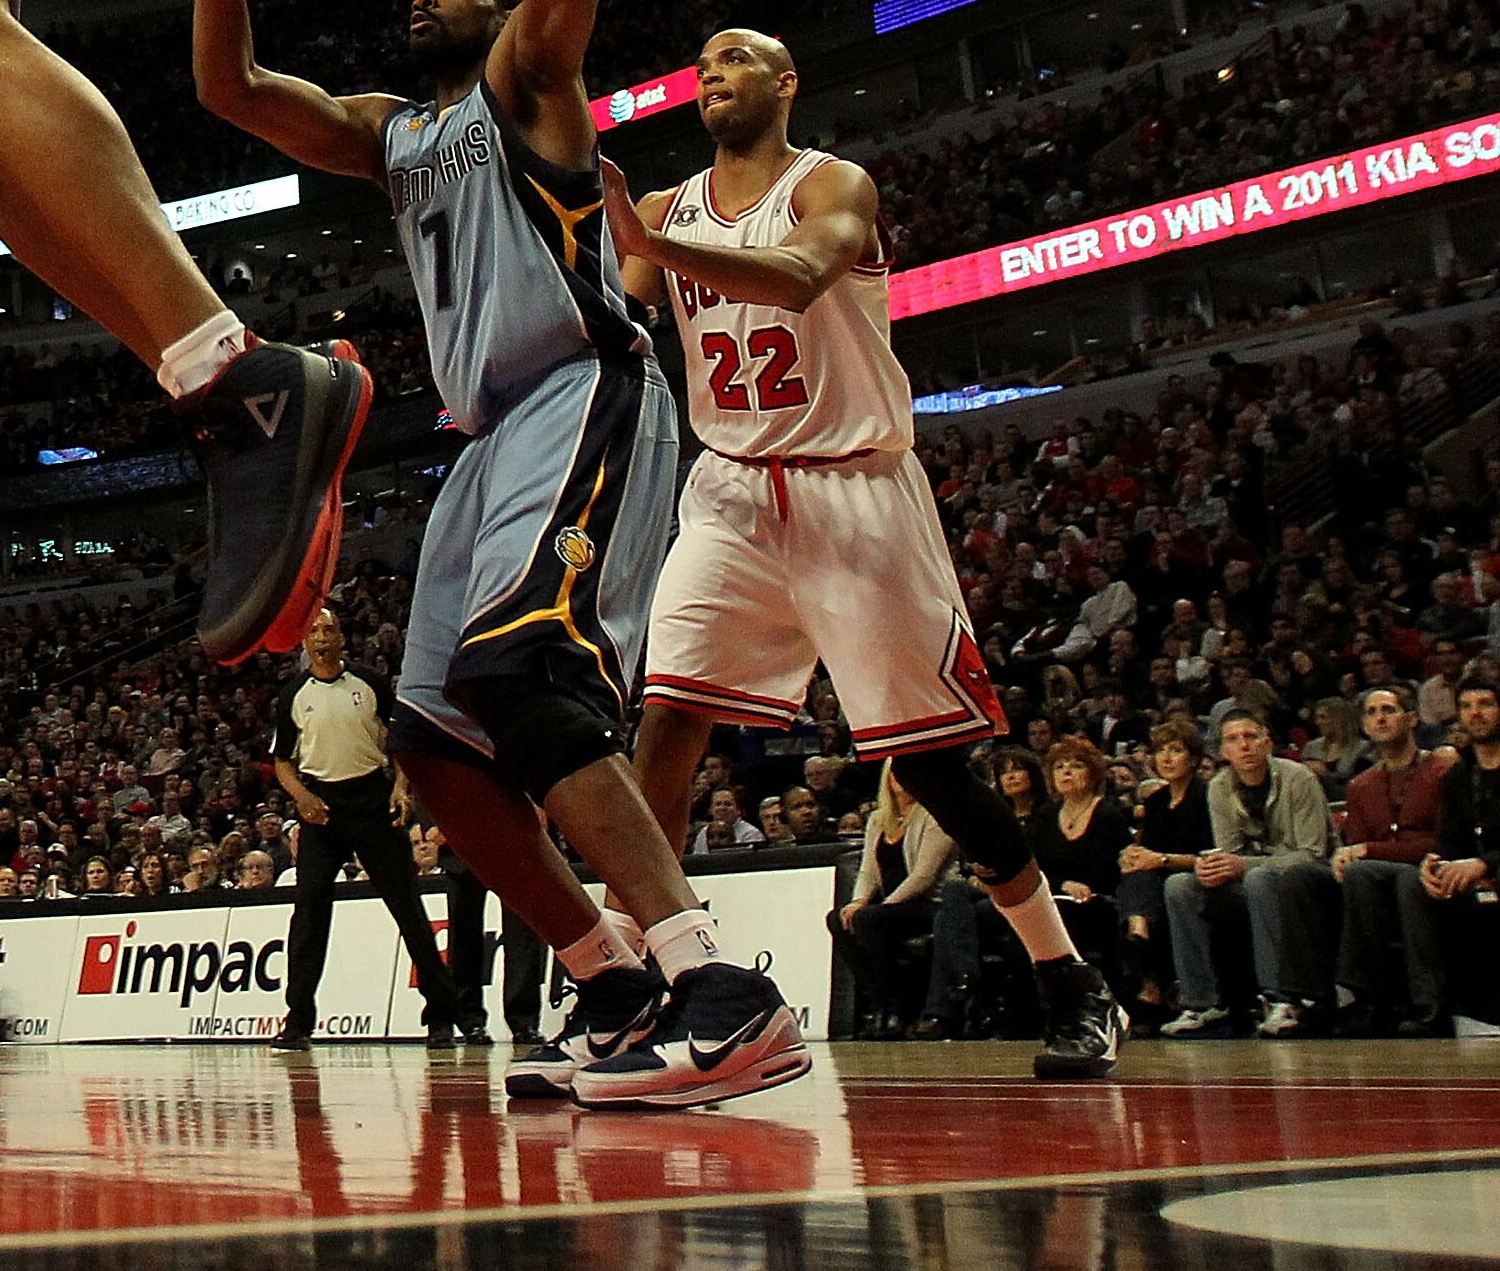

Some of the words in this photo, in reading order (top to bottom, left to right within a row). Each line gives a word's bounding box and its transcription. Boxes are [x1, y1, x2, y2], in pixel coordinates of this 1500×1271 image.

[175, 196, 229, 226] BAKING
[1000, 228, 1103, 282] ENTER
[1108, 214, 1156, 253] TO
[1161, 191, 1235, 241] WIN
[1243, 184, 1273, 221] A
[1277, 160, 1358, 211] 2011
[1366, 141, 1439, 188] KIA
[1445, 121, 1500, 167] SO
[701, 325, 810, 412] 22
[116, 920, 284, 1008] impac
